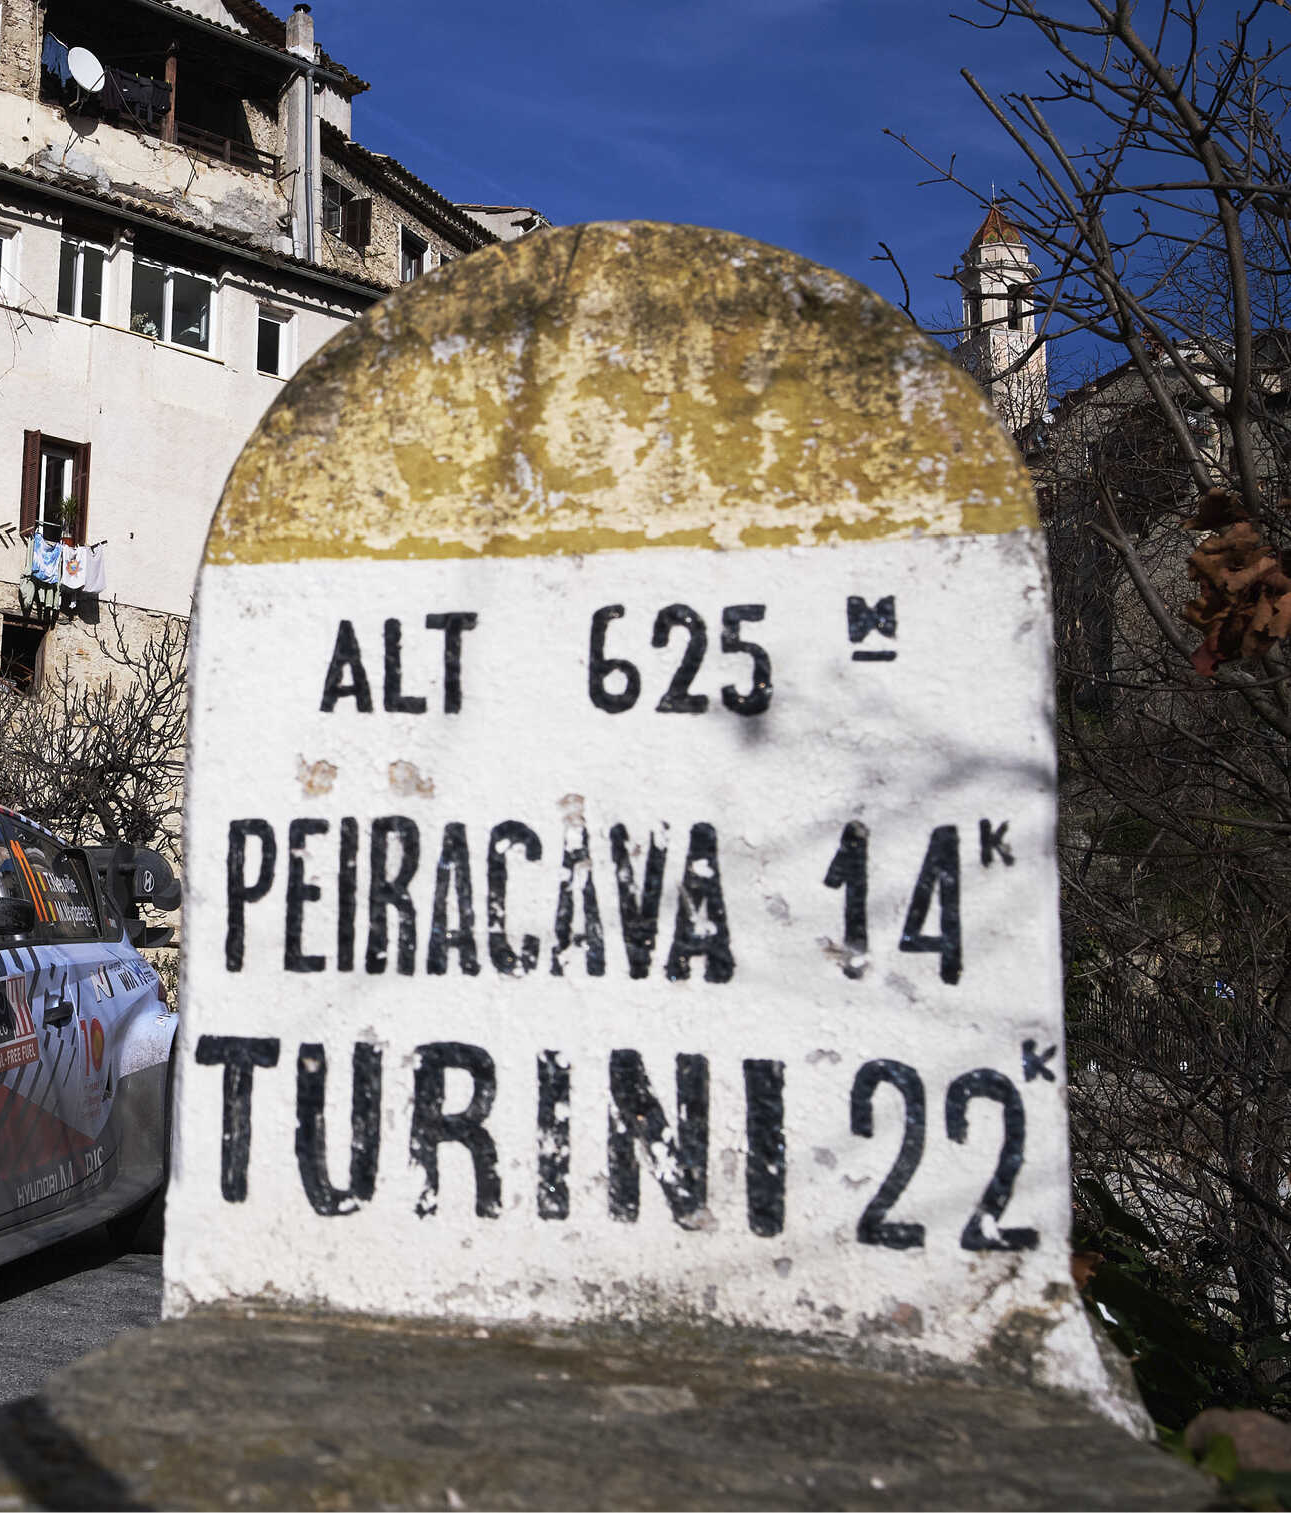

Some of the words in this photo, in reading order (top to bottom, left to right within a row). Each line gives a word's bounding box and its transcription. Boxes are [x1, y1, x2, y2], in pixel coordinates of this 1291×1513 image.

[319, 611, 478, 715] ALT
[587, 604, 774, 717] 625
[225, 814, 735, 985] PEIRACAVA
[823, 820, 962, 985] 14
[195, 1033, 786, 1237] TURINI
[848, 1058, 1042, 1252] 22
